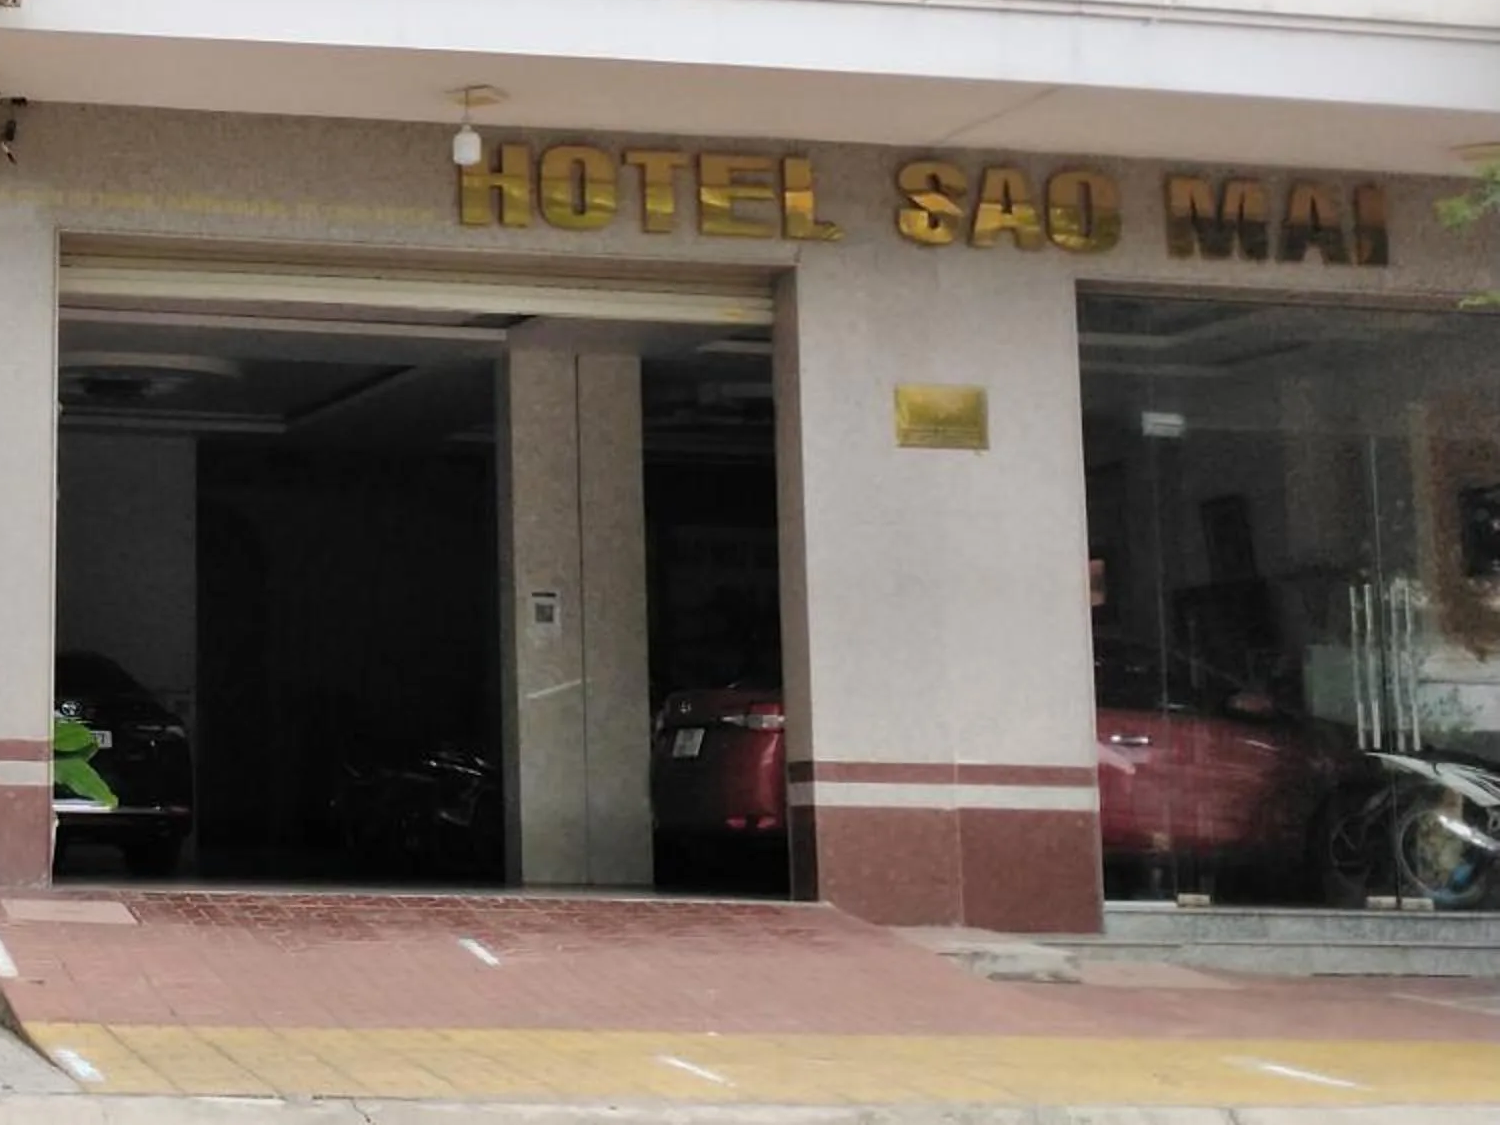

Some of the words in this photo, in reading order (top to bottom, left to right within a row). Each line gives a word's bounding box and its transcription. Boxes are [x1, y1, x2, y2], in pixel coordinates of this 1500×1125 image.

[458, 143, 844, 240] HOTEL
[896, 159, 1121, 253] SAO
[1165, 175, 1388, 267] MAI
